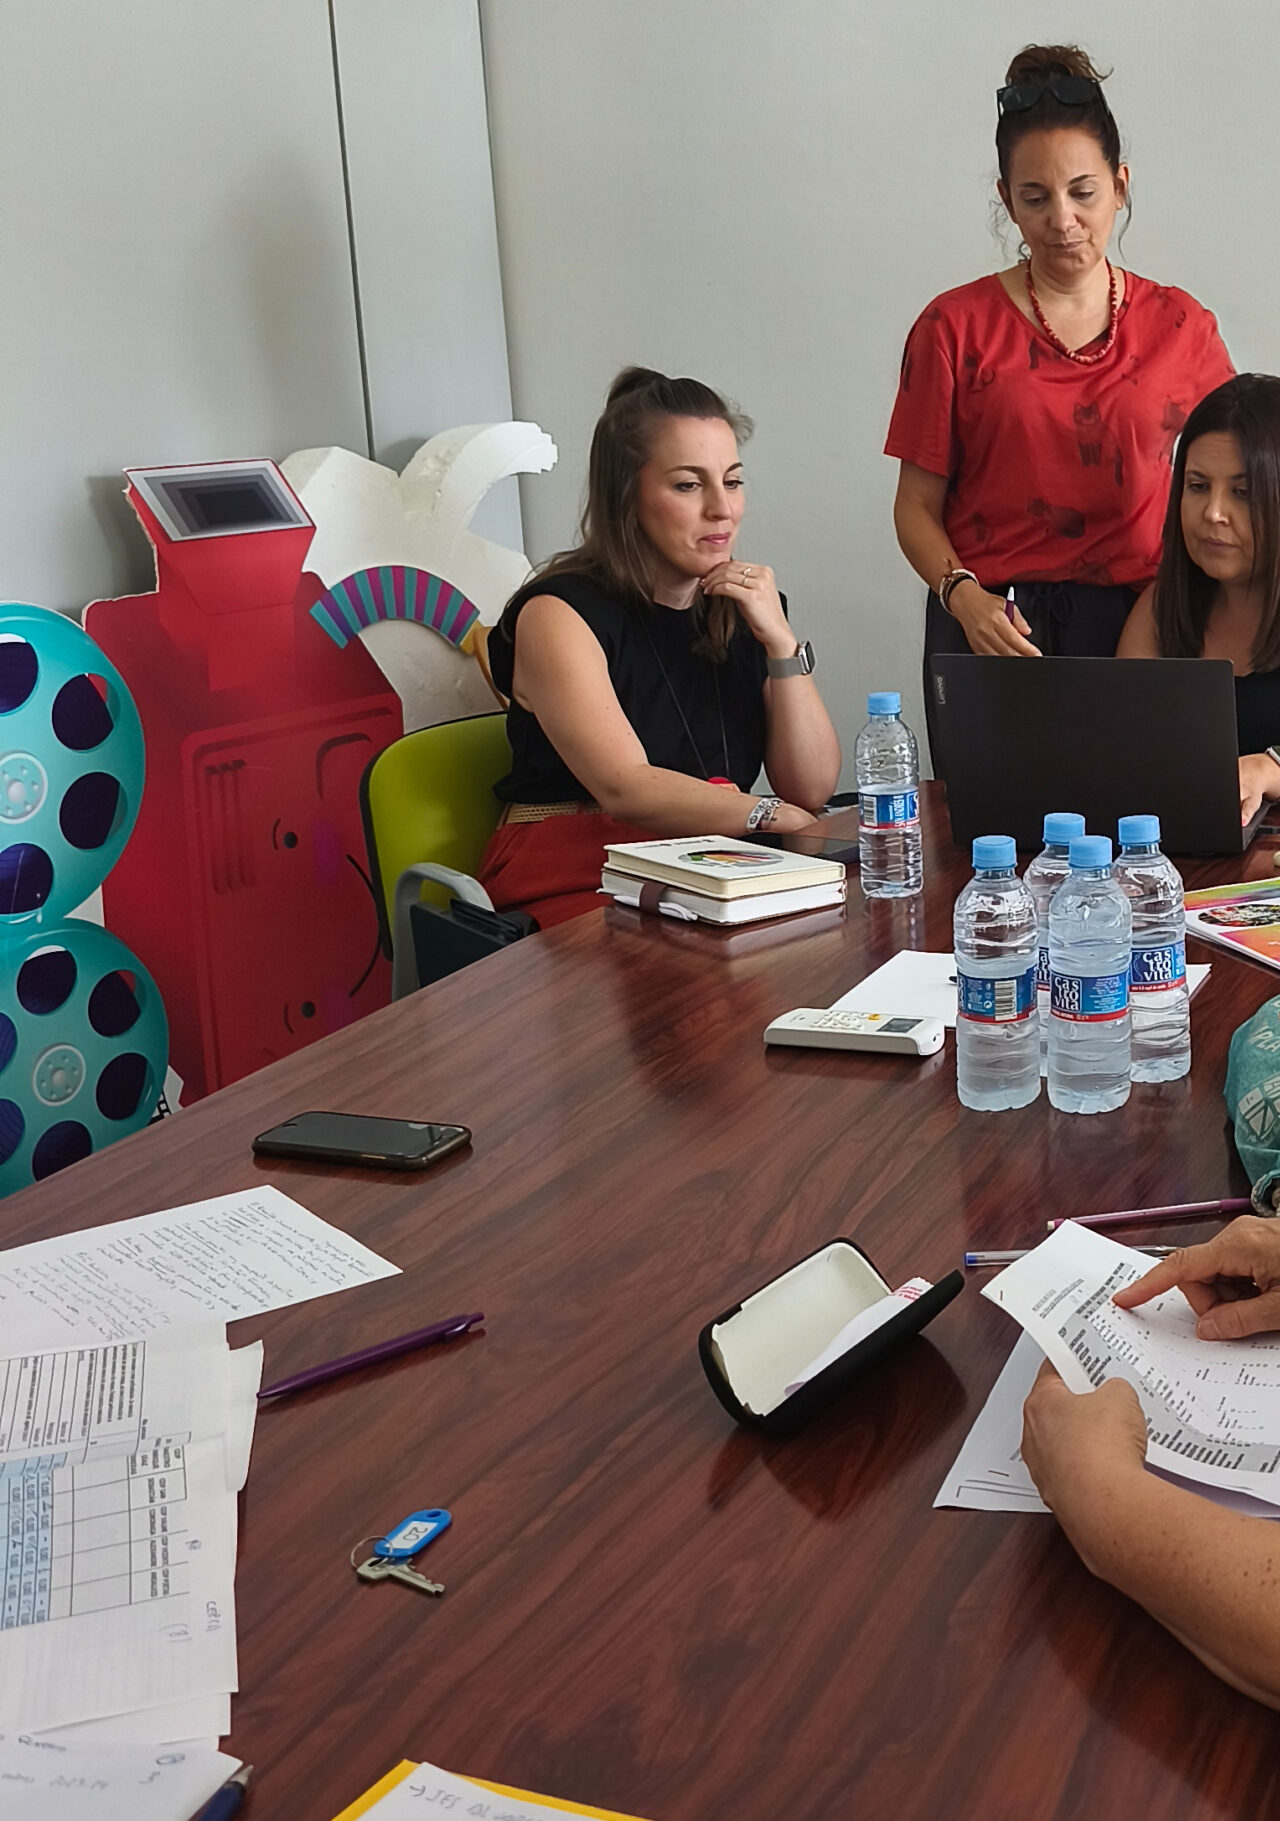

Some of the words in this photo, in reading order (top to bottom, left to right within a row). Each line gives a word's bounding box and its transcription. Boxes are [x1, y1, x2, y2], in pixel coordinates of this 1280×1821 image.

[937, 676, 946, 705] Lenovo
[1143, 949, 1171, 963] cas
[1148, 959, 1172, 973] tro
[1143, 968, 1173, 981] vita
[1054, 976, 1079, 992] cas
[1057, 986, 1080, 1001] tro
[1054, 995, 1080, 1011] vita
[403, 1526, 428, 1541] 20
